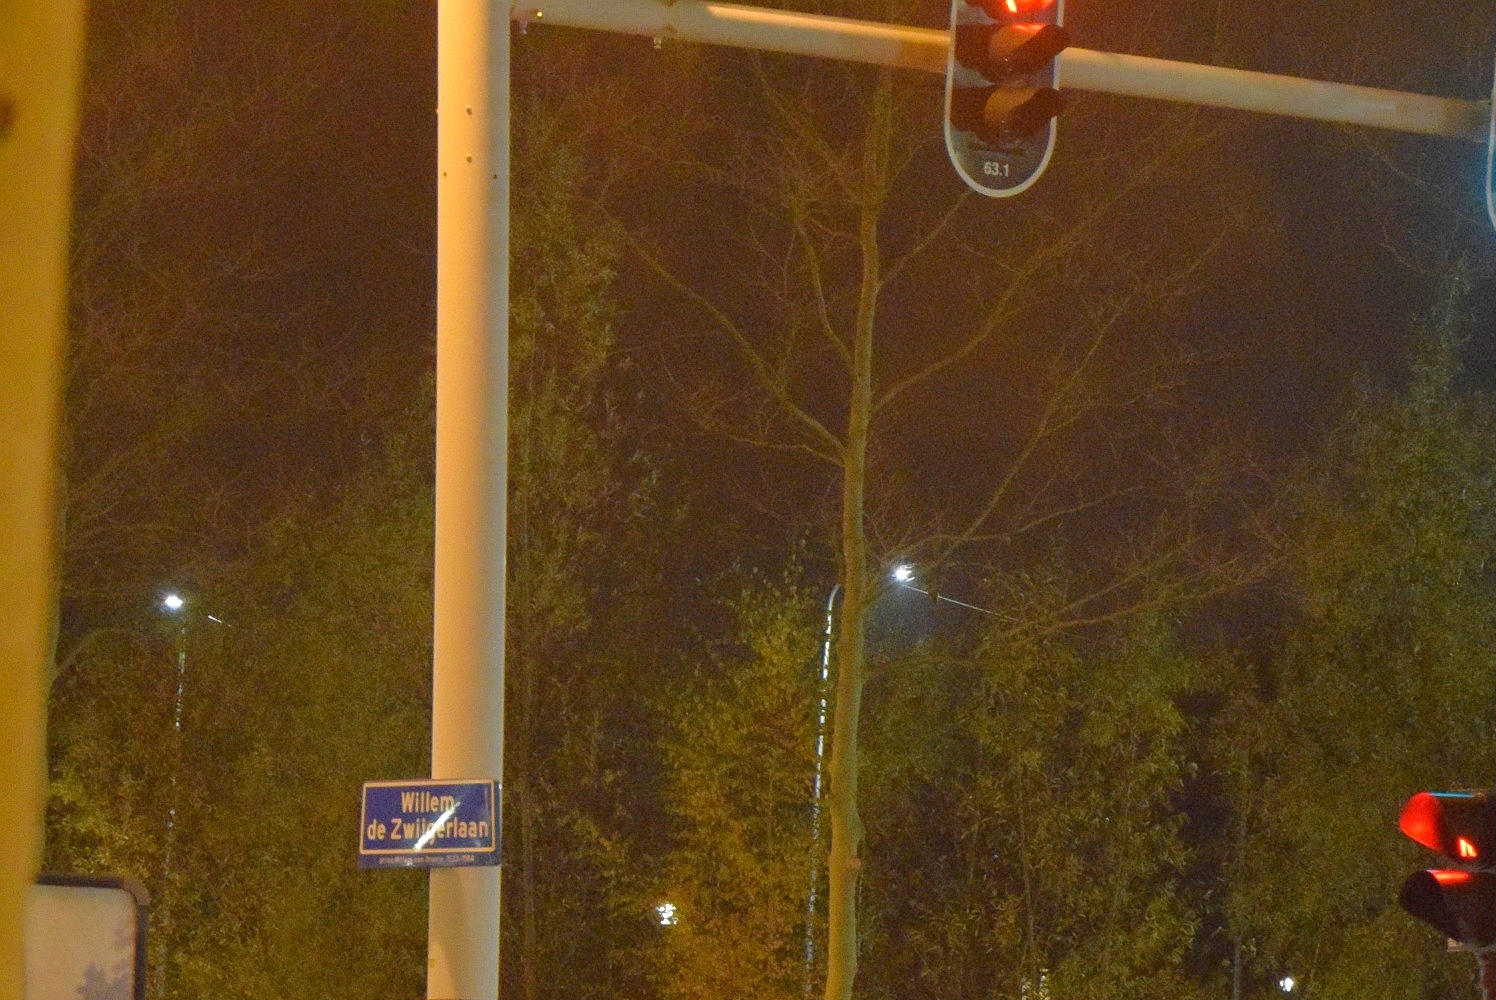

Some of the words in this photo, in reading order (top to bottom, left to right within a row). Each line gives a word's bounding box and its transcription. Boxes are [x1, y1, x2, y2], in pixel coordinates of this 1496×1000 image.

[983, 161, 1009, 177] 63.1
[401, 791, 455, 813] Willem
[367, 818, 387, 840] de
